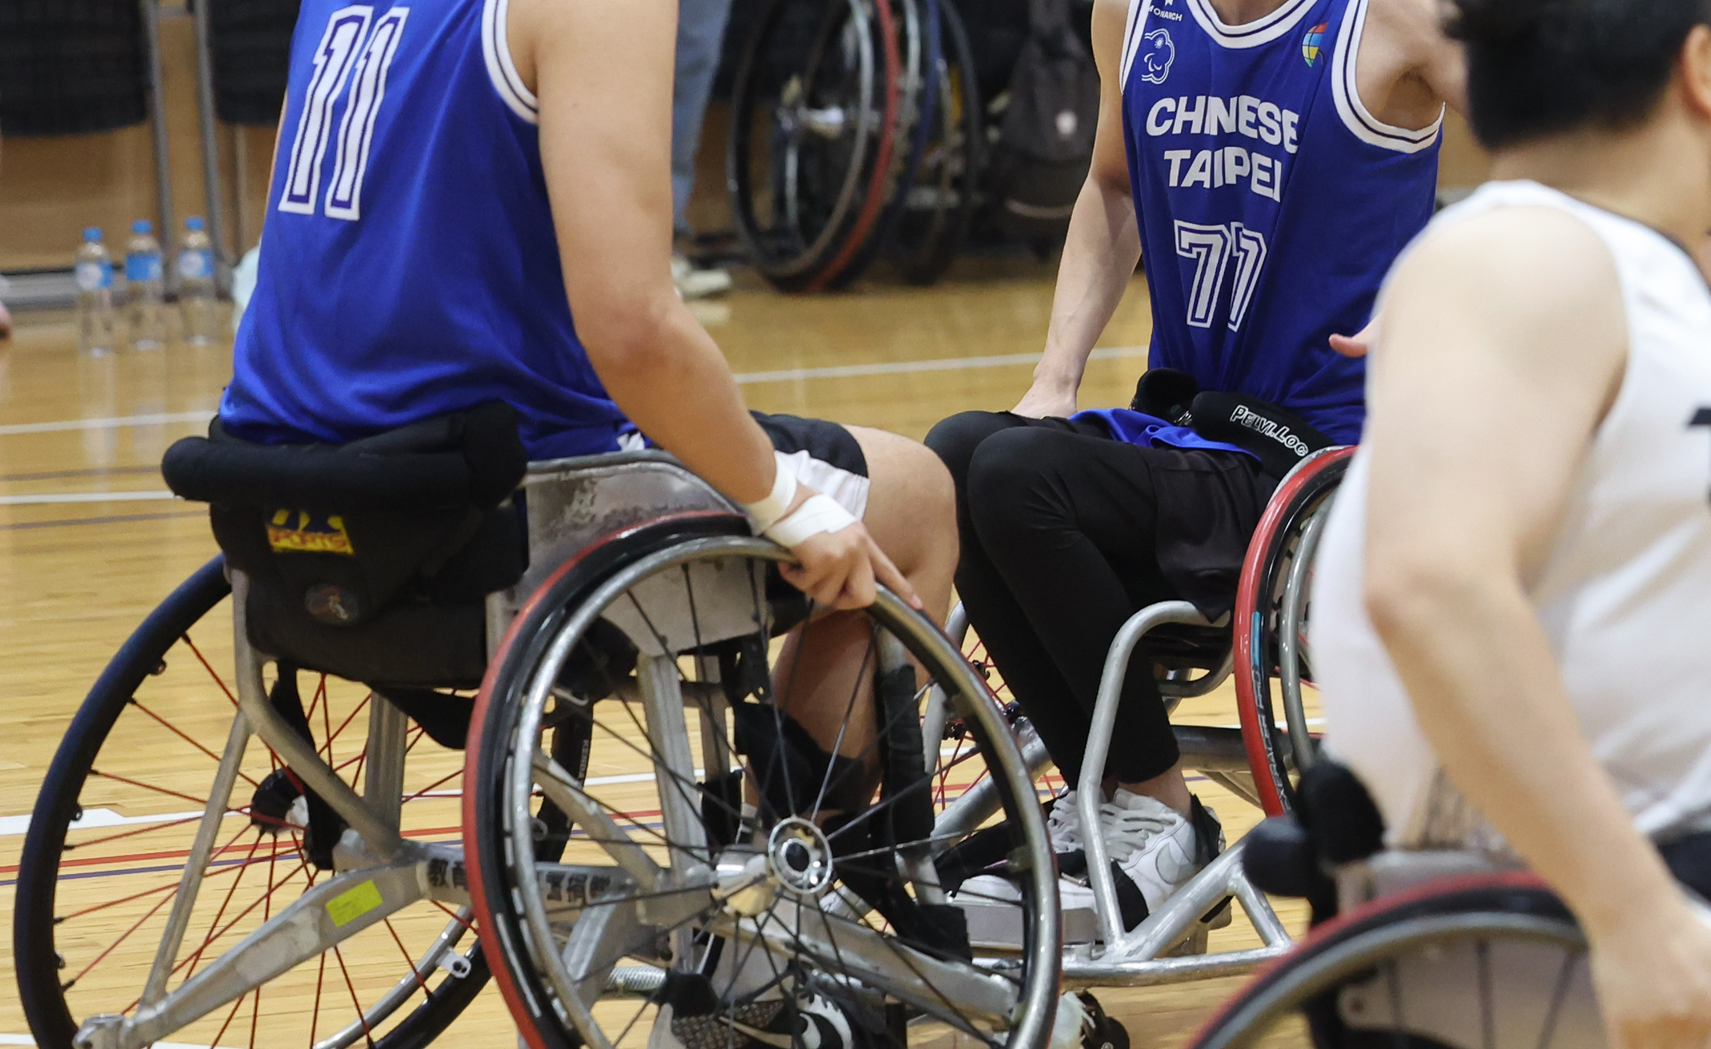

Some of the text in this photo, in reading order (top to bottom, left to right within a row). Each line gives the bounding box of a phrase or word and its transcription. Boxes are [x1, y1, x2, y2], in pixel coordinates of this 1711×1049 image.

[1149, 4, 1184, 22] MONARCH
[277, 4, 411, 222] 11
[1145, 94, 1300, 154] CHINESE
[1163, 146, 1283, 203] TAIPEI
[1173, 218, 1268, 333] 77
